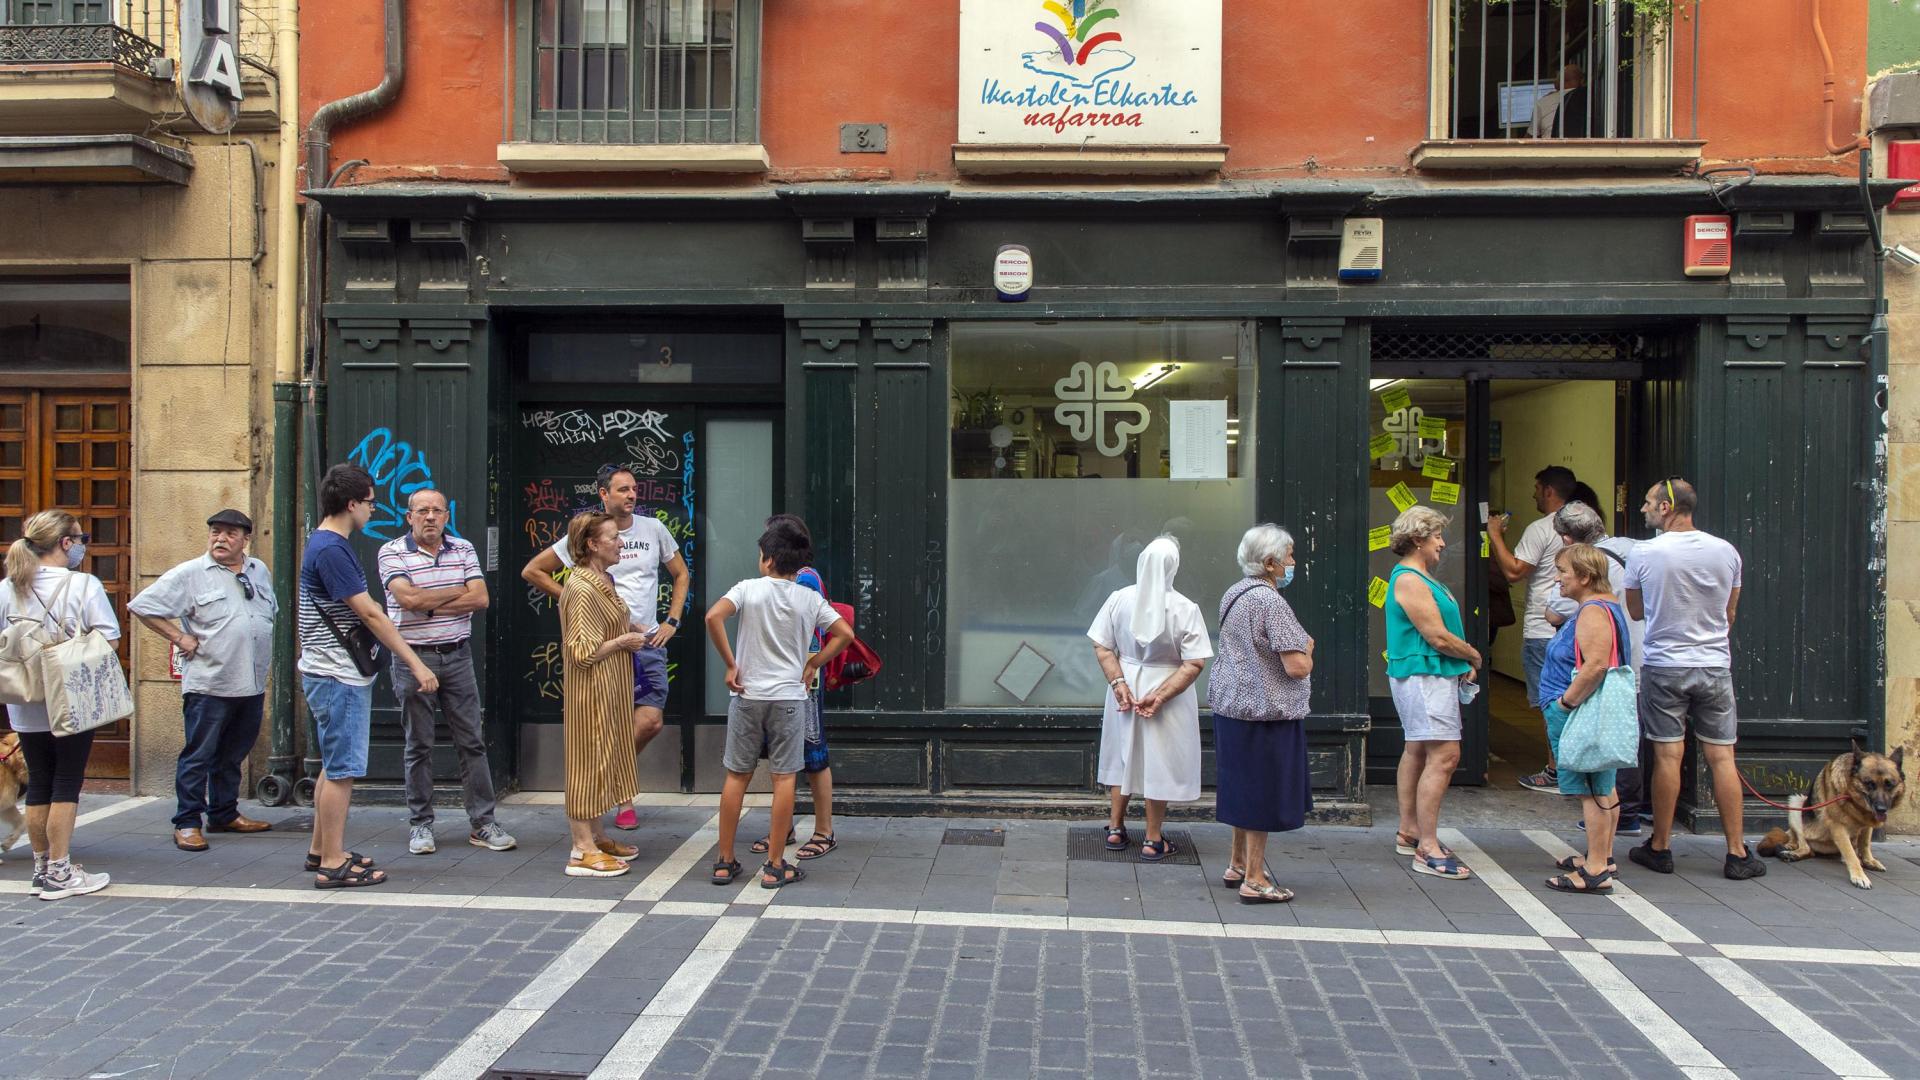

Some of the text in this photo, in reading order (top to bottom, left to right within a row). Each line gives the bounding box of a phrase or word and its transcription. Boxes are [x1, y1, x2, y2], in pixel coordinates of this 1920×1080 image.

[981, 78, 1198, 108] Ikastolen Elkartea
[1023, 105, 1143, 134] nafarroa
[659, 345, 672, 369] 3
[624, 541, 650, 551] JEANS
